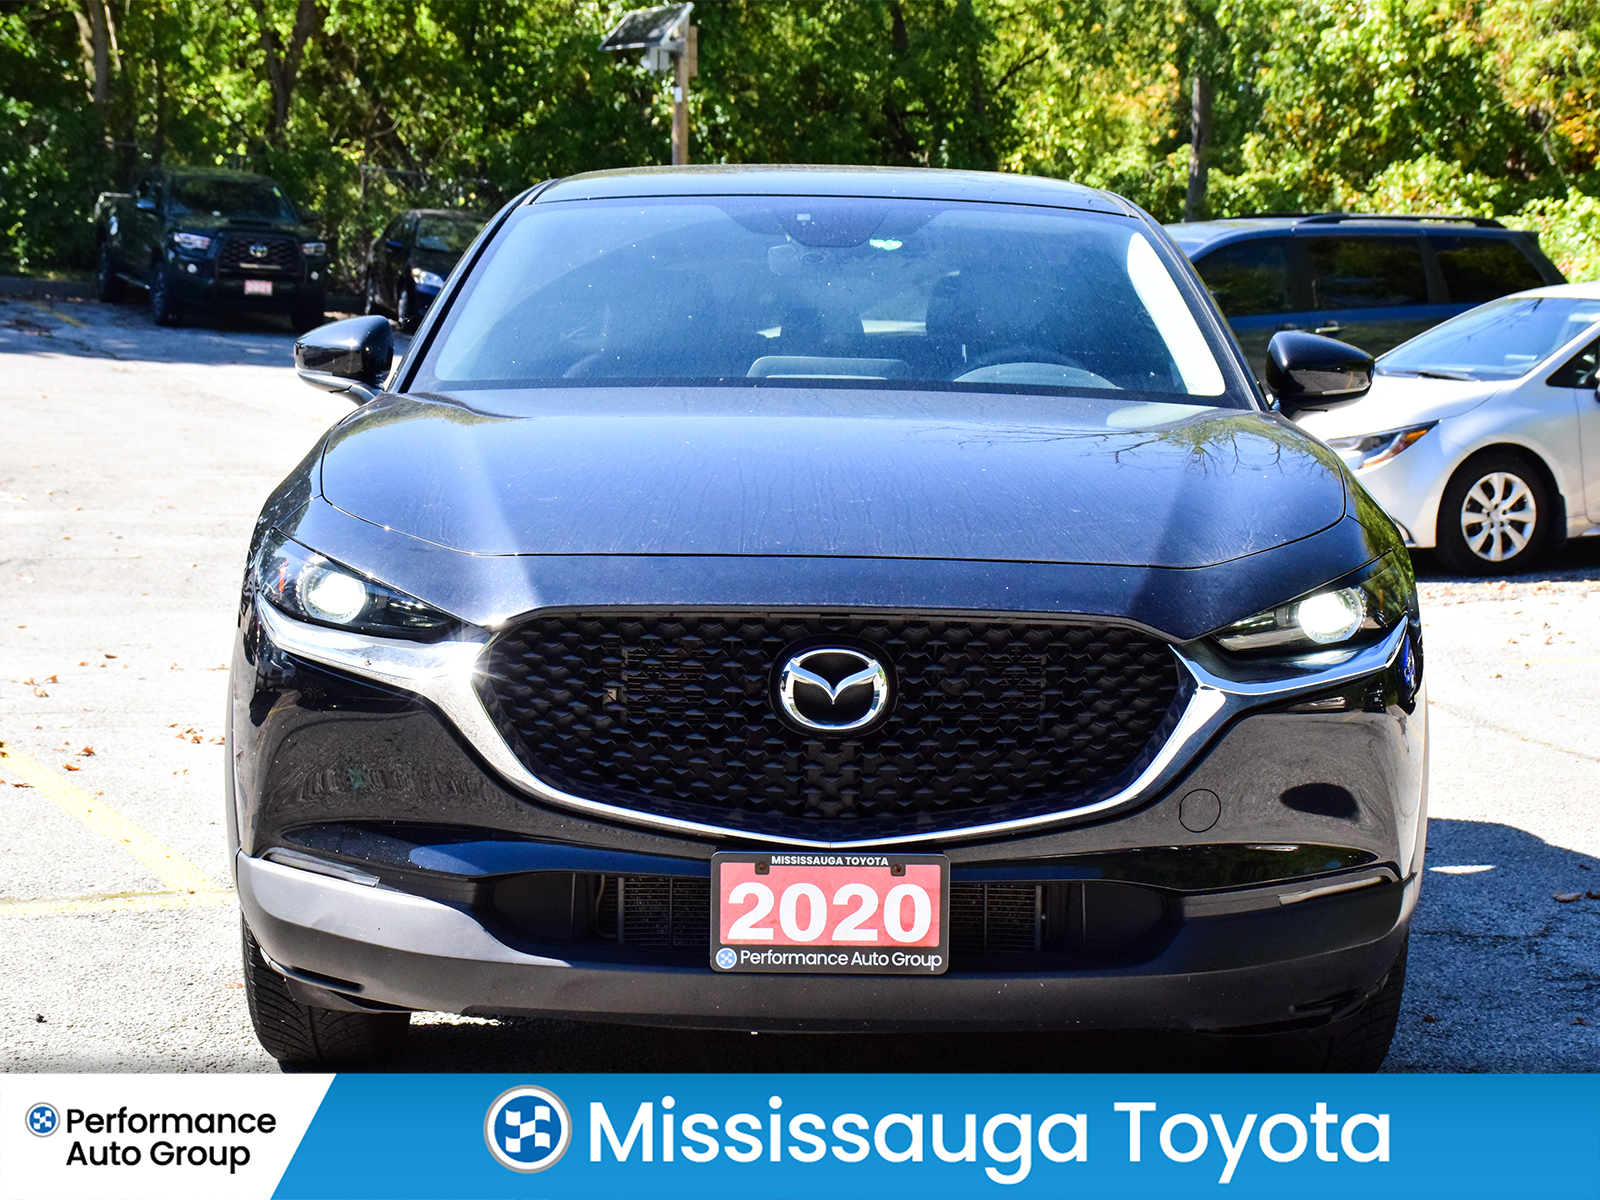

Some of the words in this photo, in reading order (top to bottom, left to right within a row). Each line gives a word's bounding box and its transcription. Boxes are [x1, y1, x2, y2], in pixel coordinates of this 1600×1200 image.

[771, 855, 843, 866] MISSISSAUGA
[845, 857, 889, 866] TOYOTA
[728, 882, 931, 943] 2020
[740, 949, 848, 966] Performance
[851, 952, 889, 967] Auto
[892, 952, 942, 971] Group
